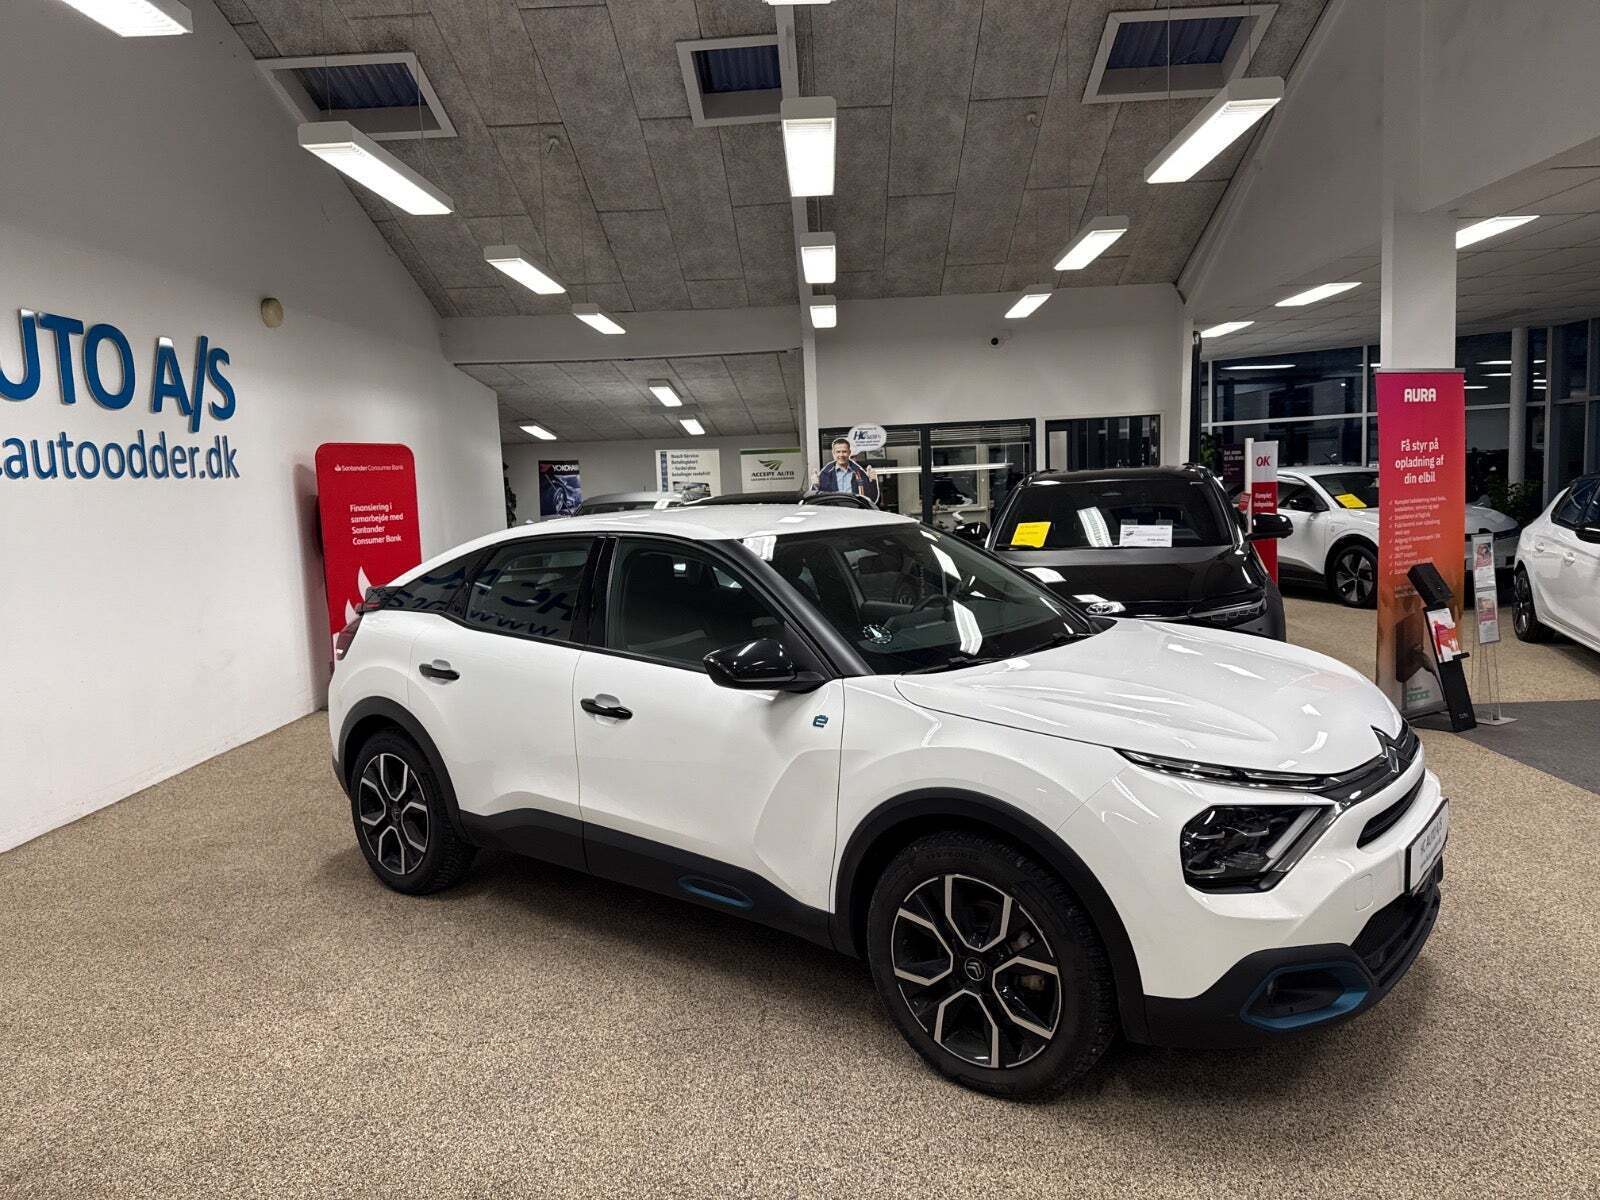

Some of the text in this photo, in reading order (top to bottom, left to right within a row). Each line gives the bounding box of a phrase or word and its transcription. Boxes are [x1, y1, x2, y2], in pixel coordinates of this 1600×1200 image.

[150, 335, 237, 433] A/S
[1404, 388, 1437, 403] AURA
[1401, 437, 1440, 453] Få styr på
[1256, 456, 1271, 467] OK
[1395, 454, 1445, 470] opladning af
[1404, 471, 1436, 484] din elbil
[350, 503, 389, 512] Finansiering
[351, 512, 404, 523] samarbejde med
[351, 525, 385, 534] Santander
[352, 534, 402, 545] Consumer Bank
